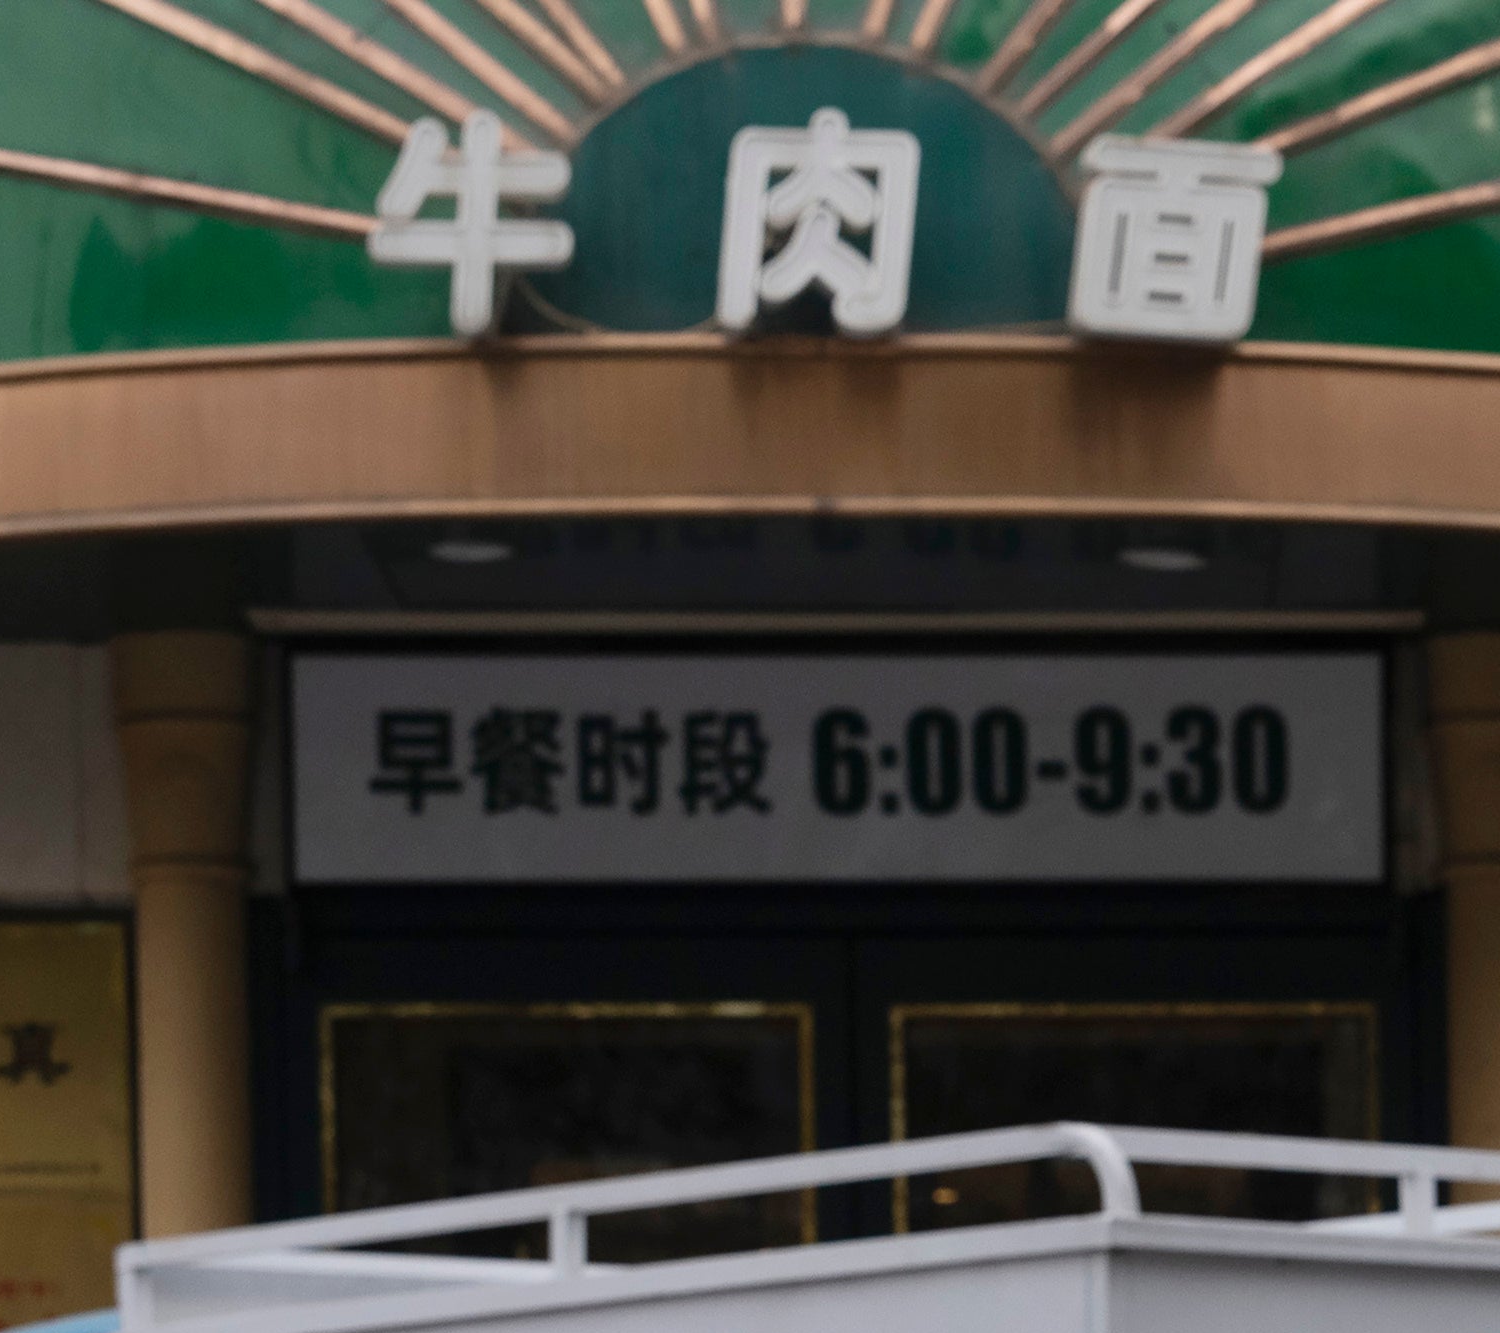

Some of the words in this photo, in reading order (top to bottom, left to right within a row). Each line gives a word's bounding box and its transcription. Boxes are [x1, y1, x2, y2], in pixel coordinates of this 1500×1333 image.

[366, 106, 1286, 345] 牛肉面
[368, 707, 772, 817] 早餐时段
[811, 702, 1292, 819] 6:00-9:30
